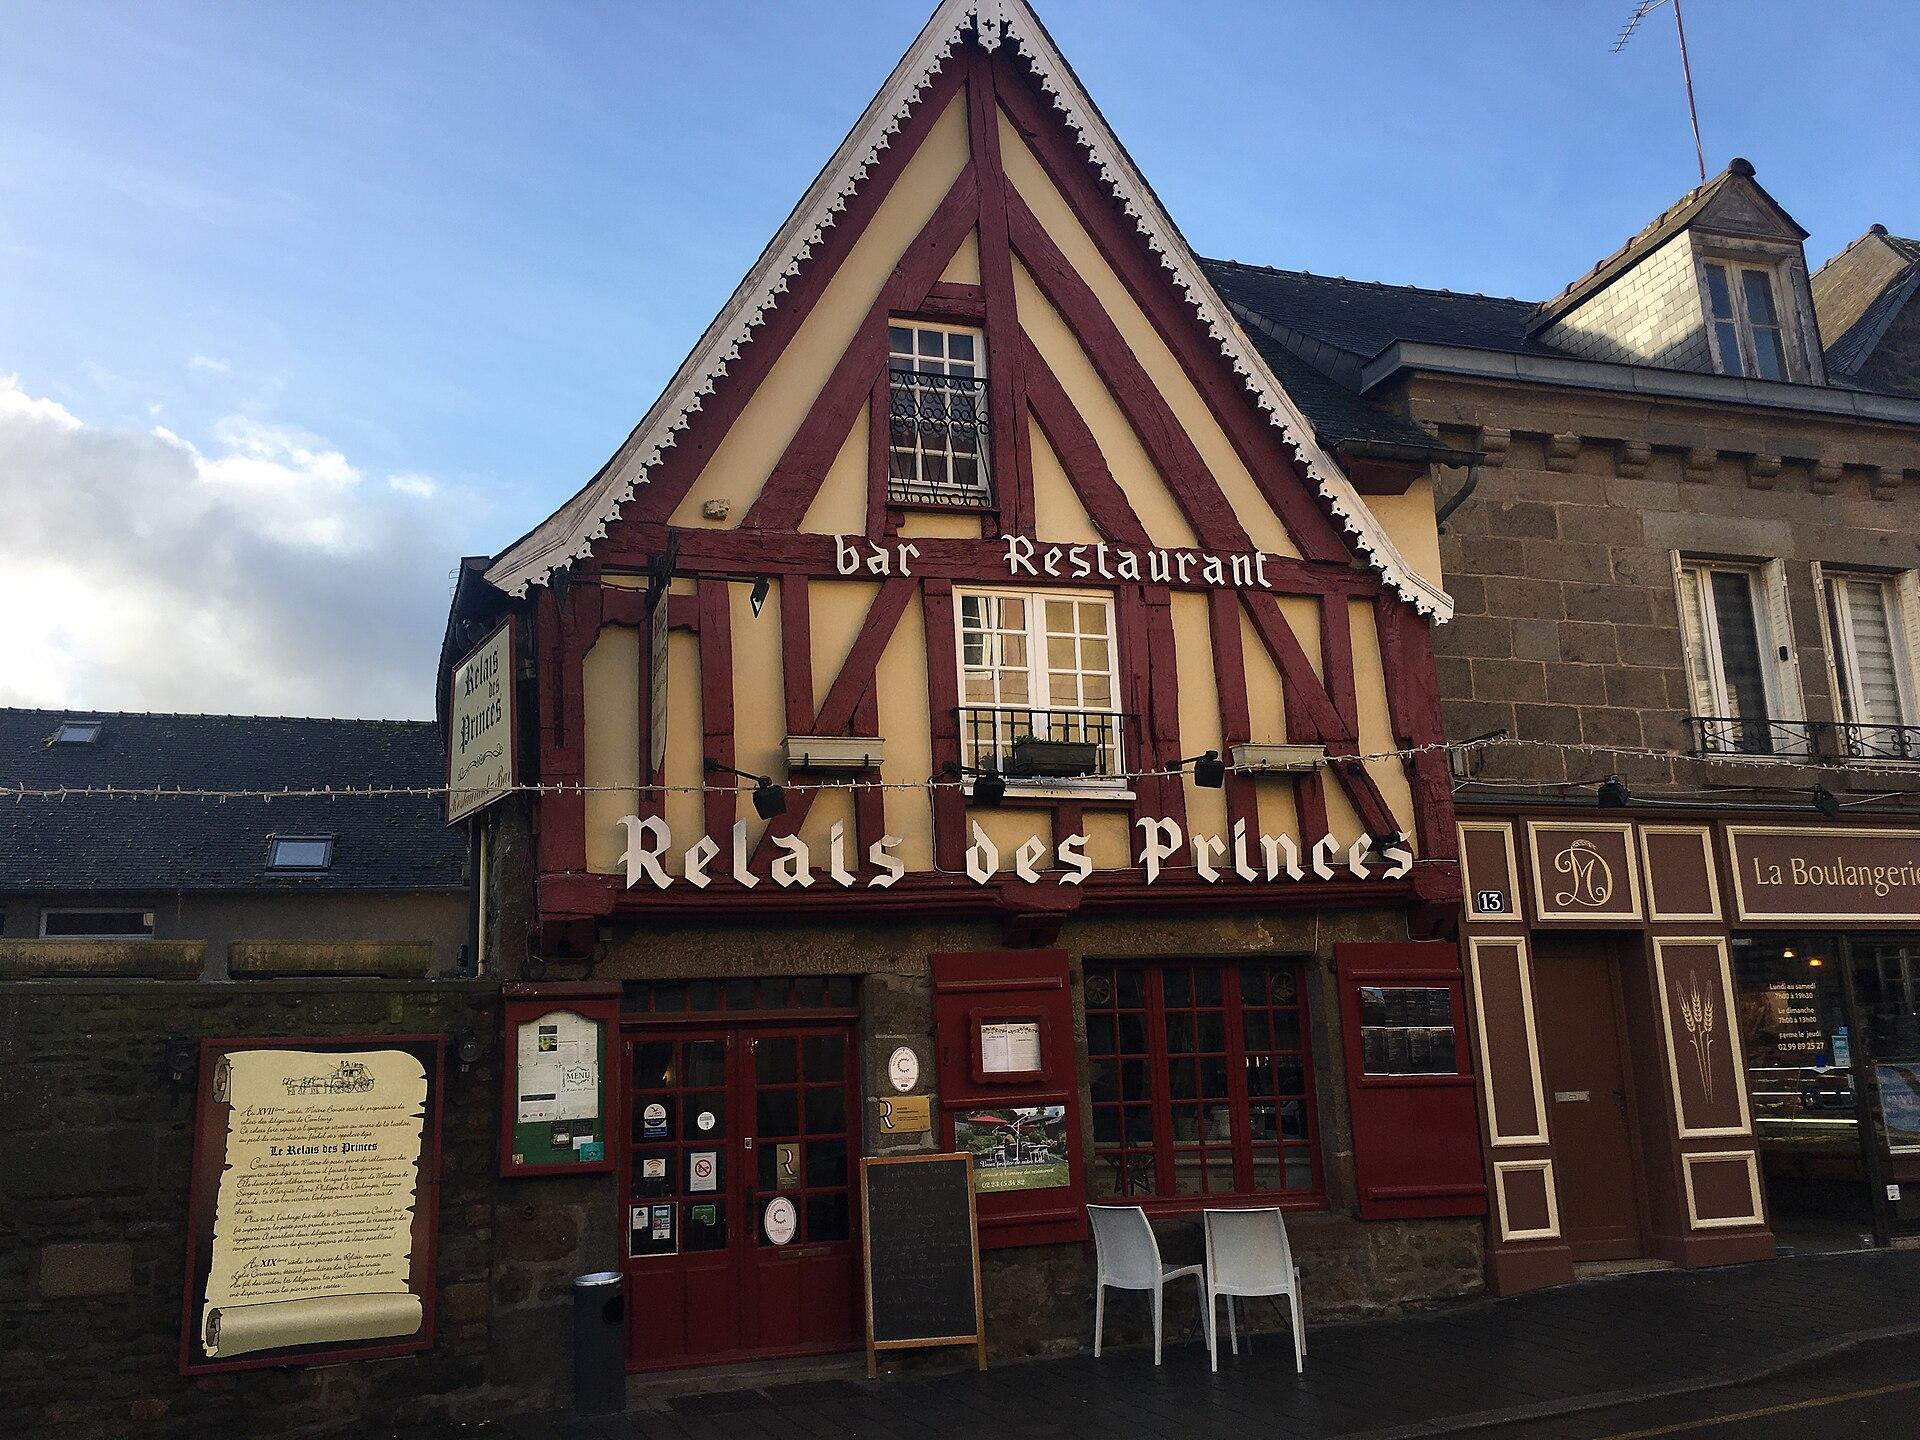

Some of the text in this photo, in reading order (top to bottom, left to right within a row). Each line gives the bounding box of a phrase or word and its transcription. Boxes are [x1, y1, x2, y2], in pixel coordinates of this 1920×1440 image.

[835, 533, 1273, 588] bar Restaurant
[464, 651, 499, 699] Relais
[488, 676, 500, 698] des
[460, 698, 502, 754] Princes
[616, 814, 1413, 890] Relais des Princes
[1753, 857, 1783, 886] La
[1480, 893, 1501, 910] 13
[1769, 982, 1786, 990] Lundi
[1795, 982, 1817, 990] samedi
[1786, 1006, 1815, 1014] dimanche
[1797, 1042, 1806, 1050] 89
[1806, 1042, 1816, 1050] 25
[1816, 1042, 1825, 1050] 27
[566, 1071, 591, 1080] MENU
[270, 1142, 378, 1156] Le Relais des Princes
